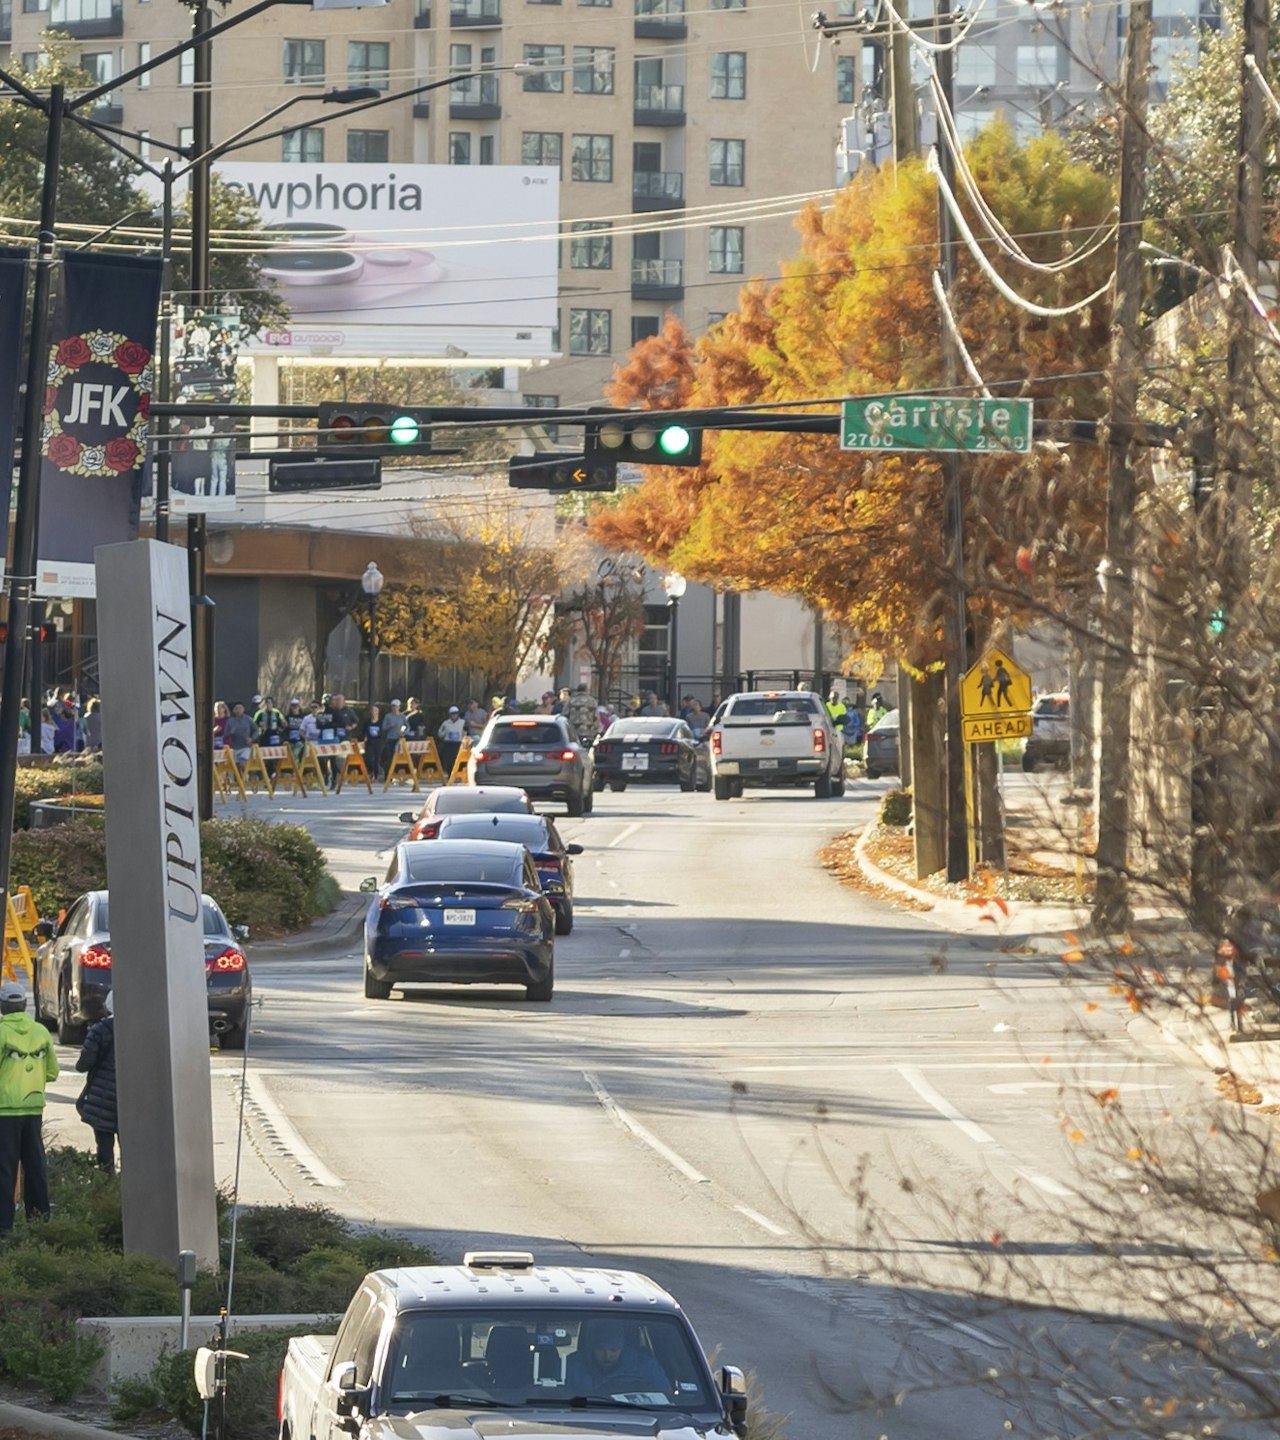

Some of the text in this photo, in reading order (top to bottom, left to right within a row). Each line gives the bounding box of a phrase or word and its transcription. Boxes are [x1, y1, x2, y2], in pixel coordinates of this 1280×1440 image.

[293, 333, 341, 343] OUTDOOR
[63, 382, 130, 427] JFK
[847, 432, 894, 447] 2700
[971, 720, 1026, 737] AHEAD
[155, 604, 200, 924] UPTOWN
